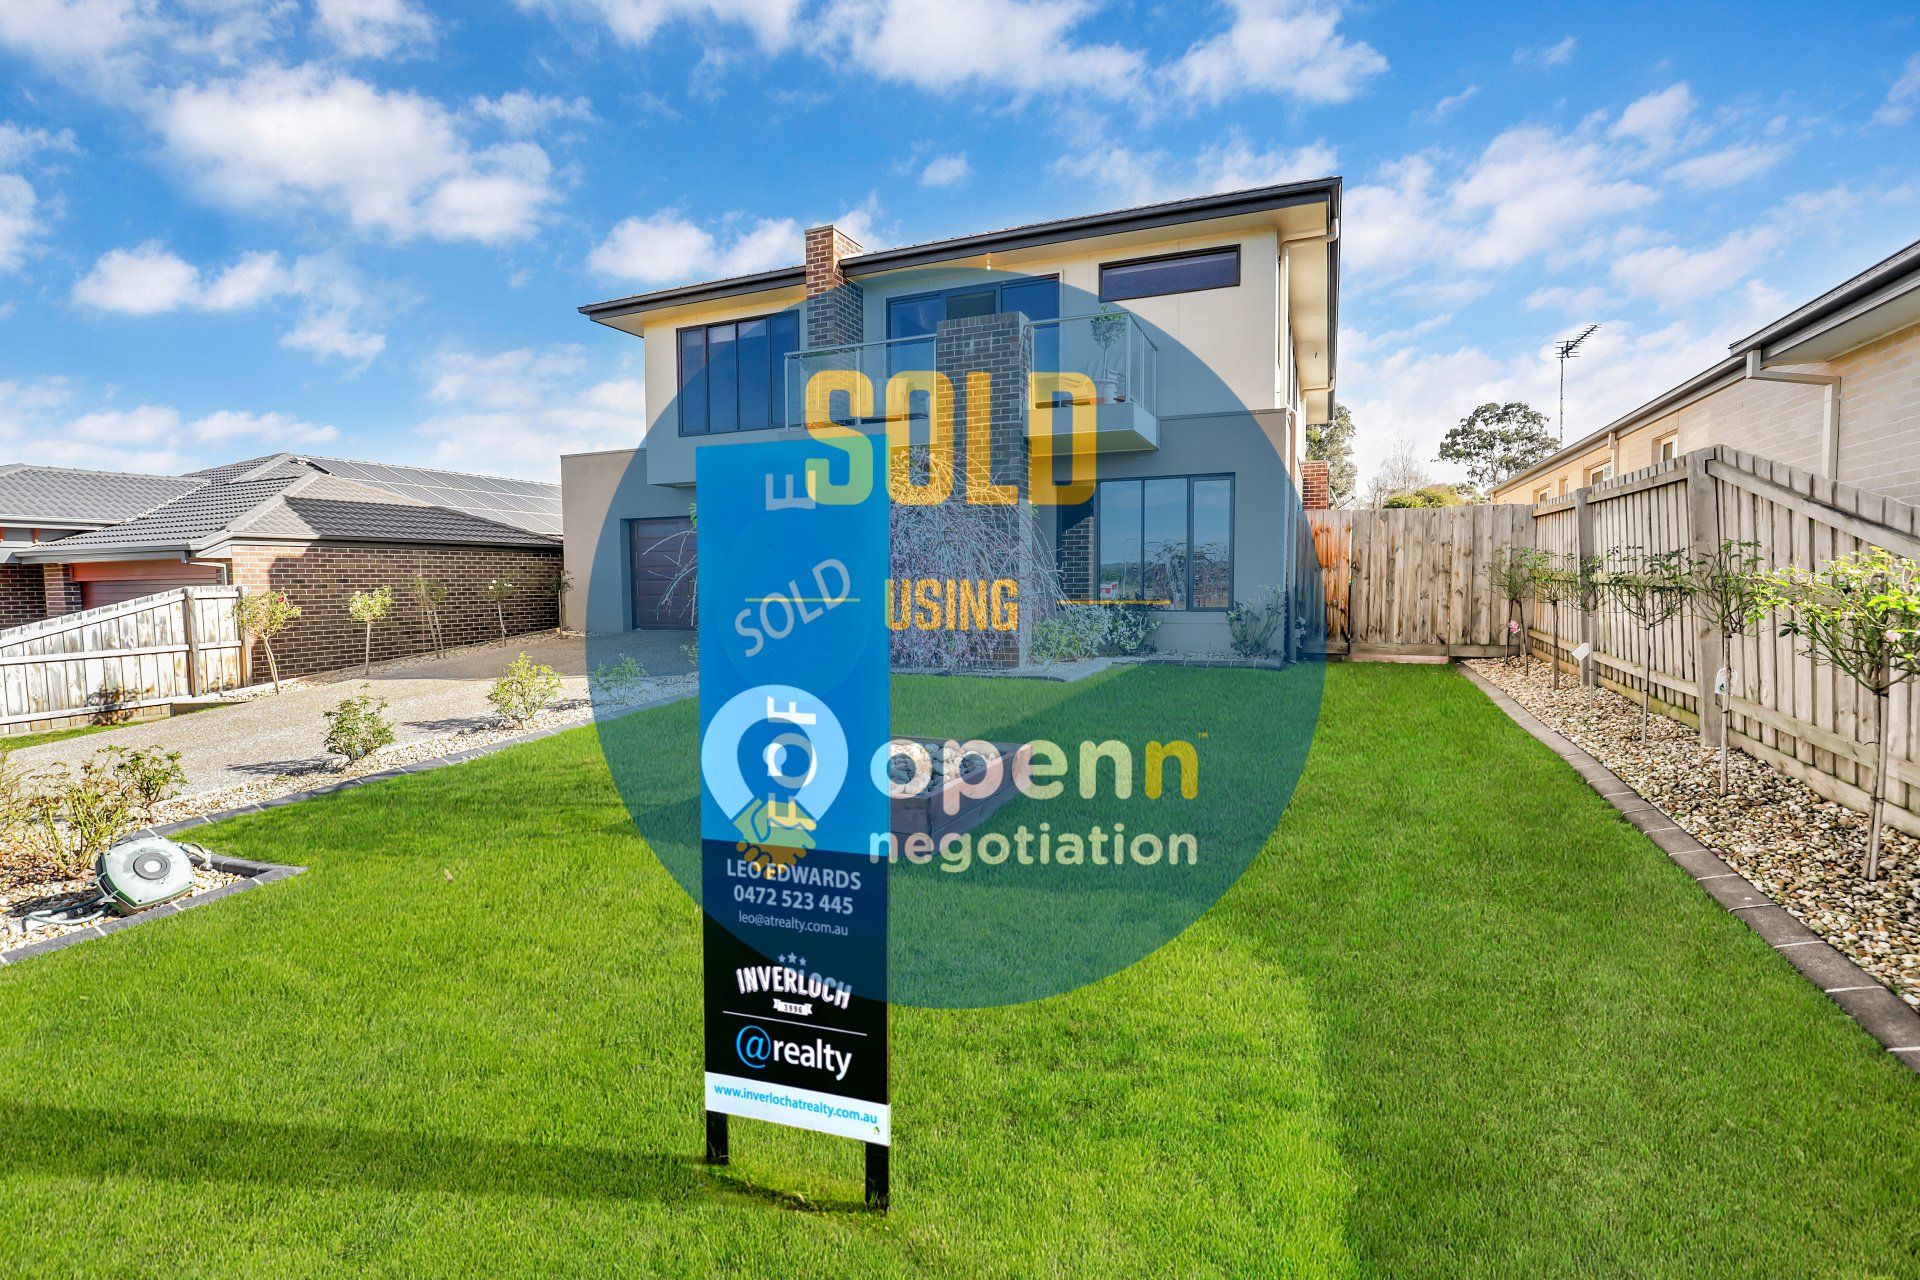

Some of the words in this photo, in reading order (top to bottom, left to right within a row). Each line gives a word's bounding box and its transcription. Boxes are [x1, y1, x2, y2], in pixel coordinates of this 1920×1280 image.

[734, 558, 851, 658] SOLD
[726, 859, 762, 879] LEO
[766, 863, 862, 891] EDWARDS
[733, 885, 777, 906] 0472
[781, 890, 815, 911] 523
[818, 895, 854, 915] 445
[738, 910, 849, 936] leo@atrealty.com.au
[736, 965, 853, 1010] INVERLOCH
[736, 1025, 853, 1081] @realty
[714, 1084, 878, 1125] www.inverlochatrealty.com.au
